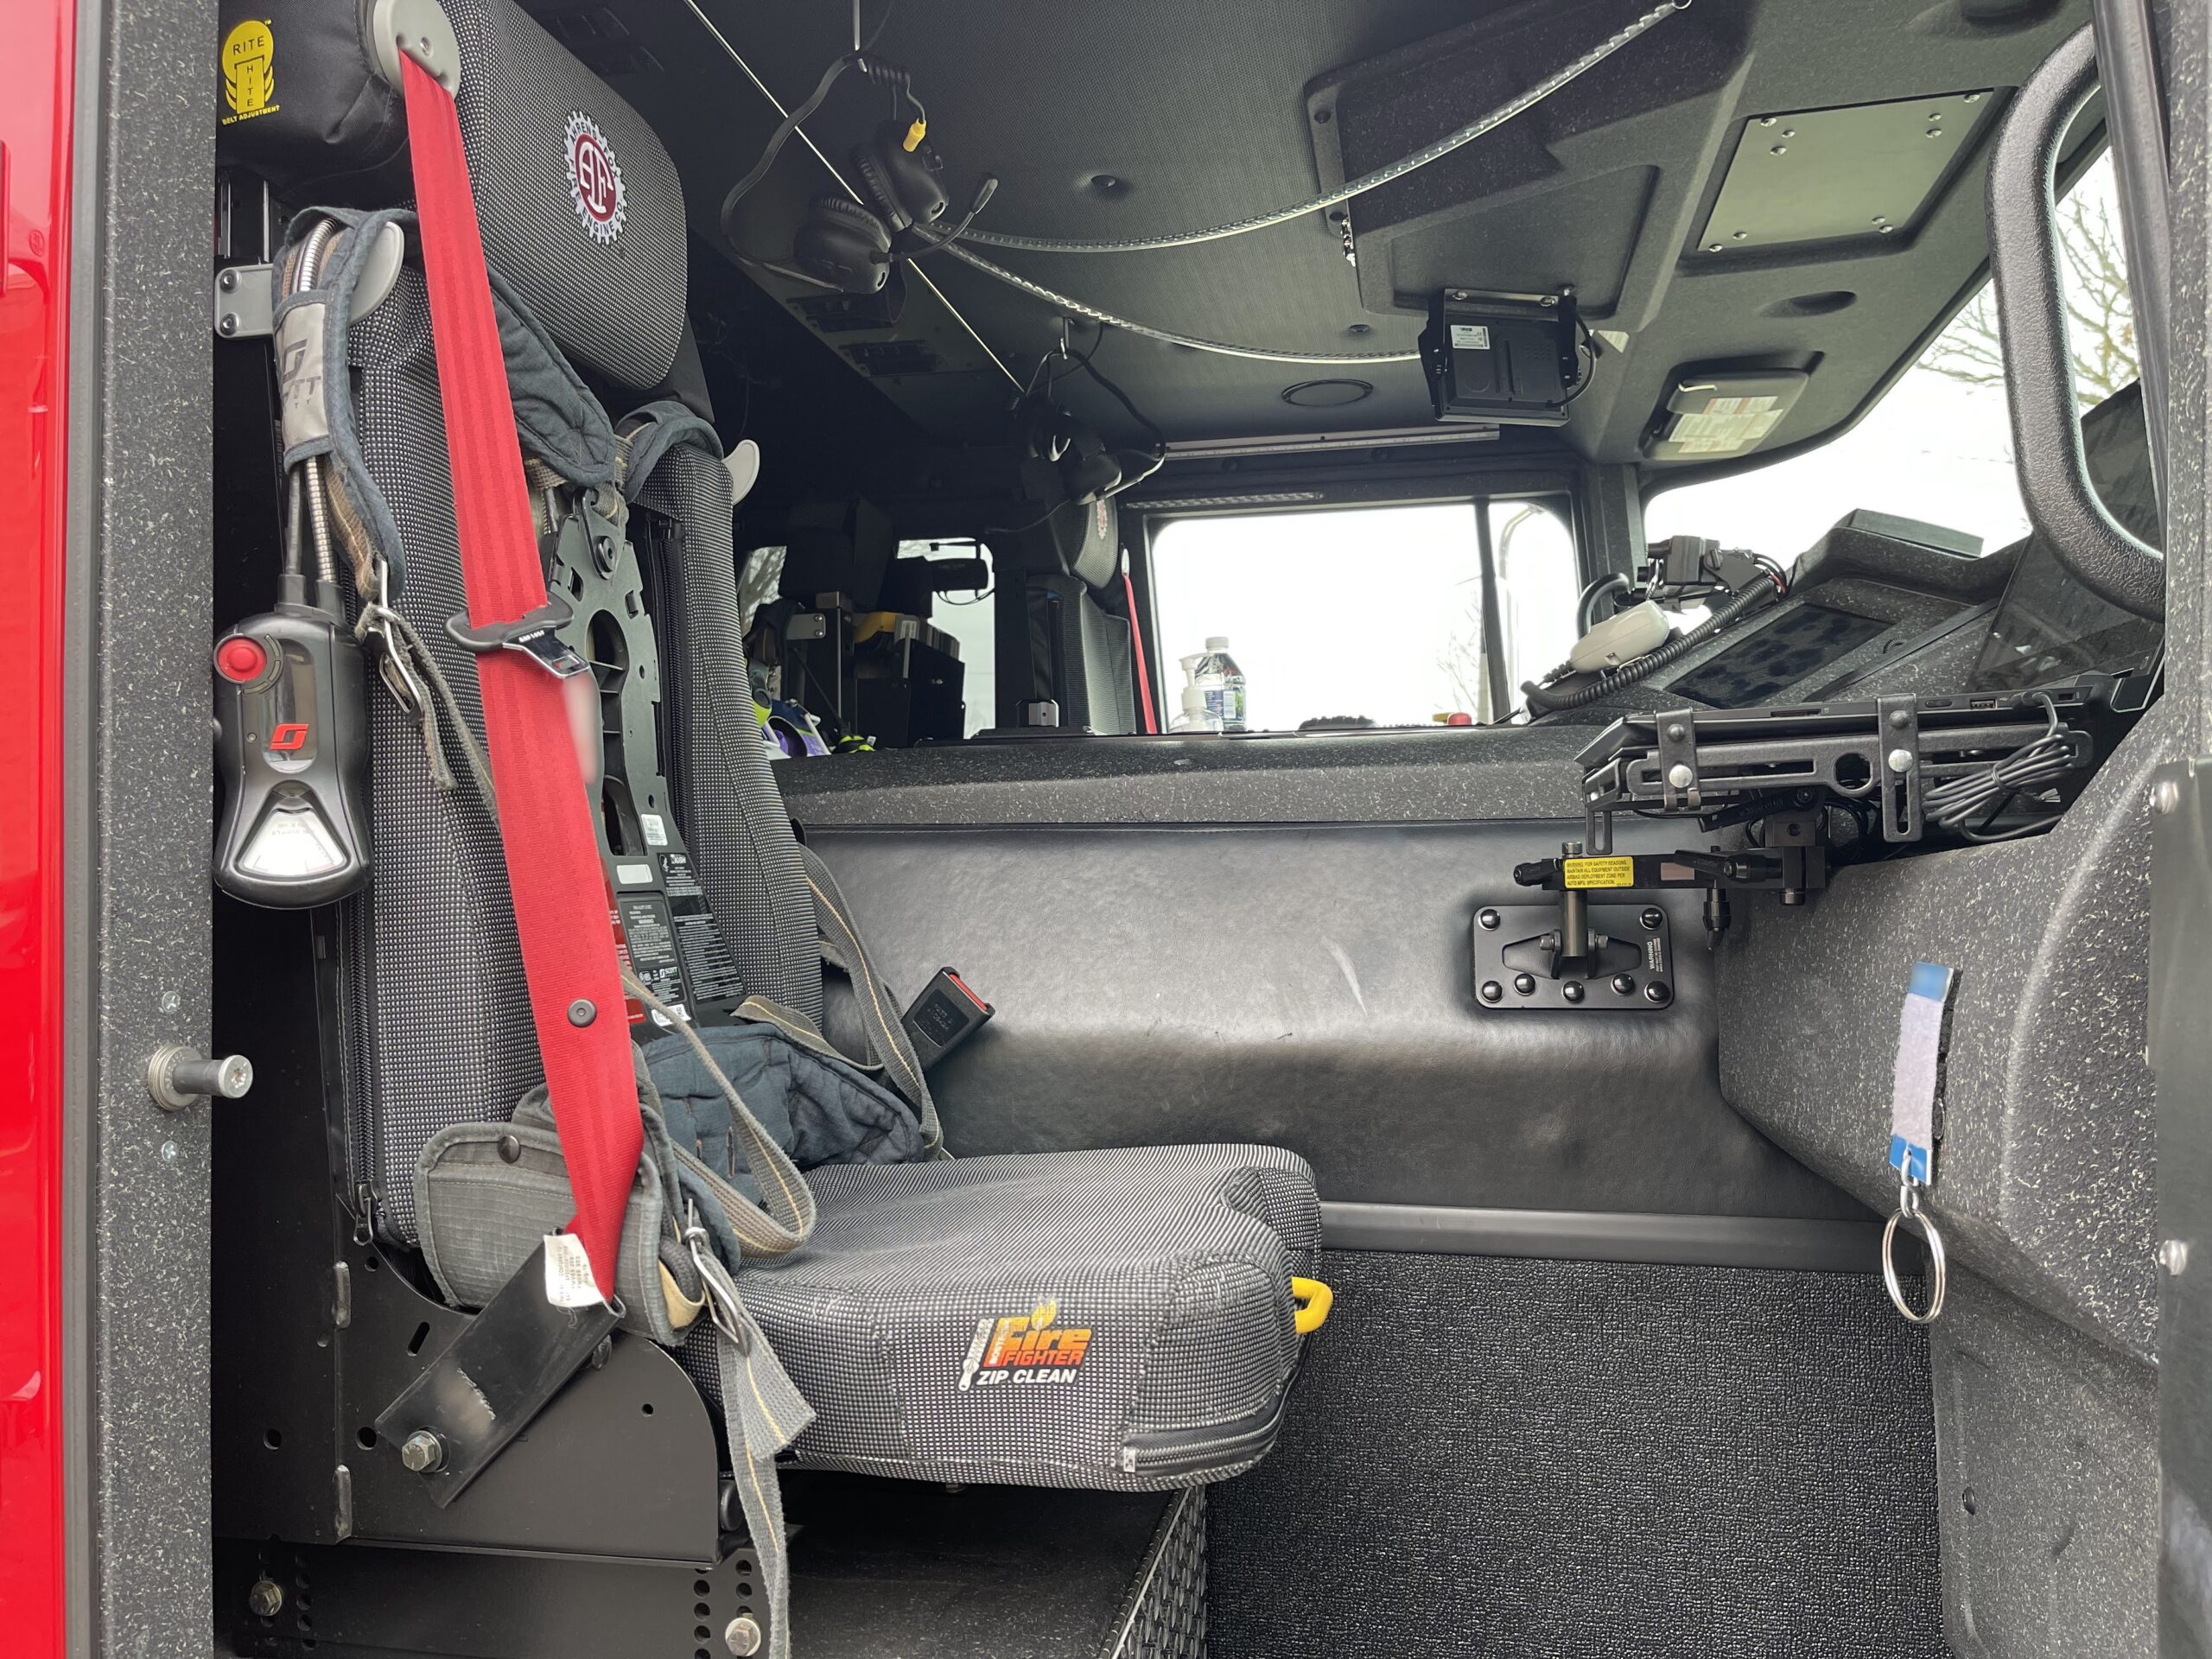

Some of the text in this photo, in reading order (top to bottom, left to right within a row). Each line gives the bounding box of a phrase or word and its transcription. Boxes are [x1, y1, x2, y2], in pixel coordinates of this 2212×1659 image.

[232, 35, 264, 56] RITE
[222, 105, 281, 125] BELT ADJUSTMENT
[582, 207, 615, 235] ENGINE
[1647, 941, 1656, 969] WARNING
[1003, 1350, 1085, 1366] FIGHTER
[976, 1368, 1077, 1385] ZIP CLEAN
